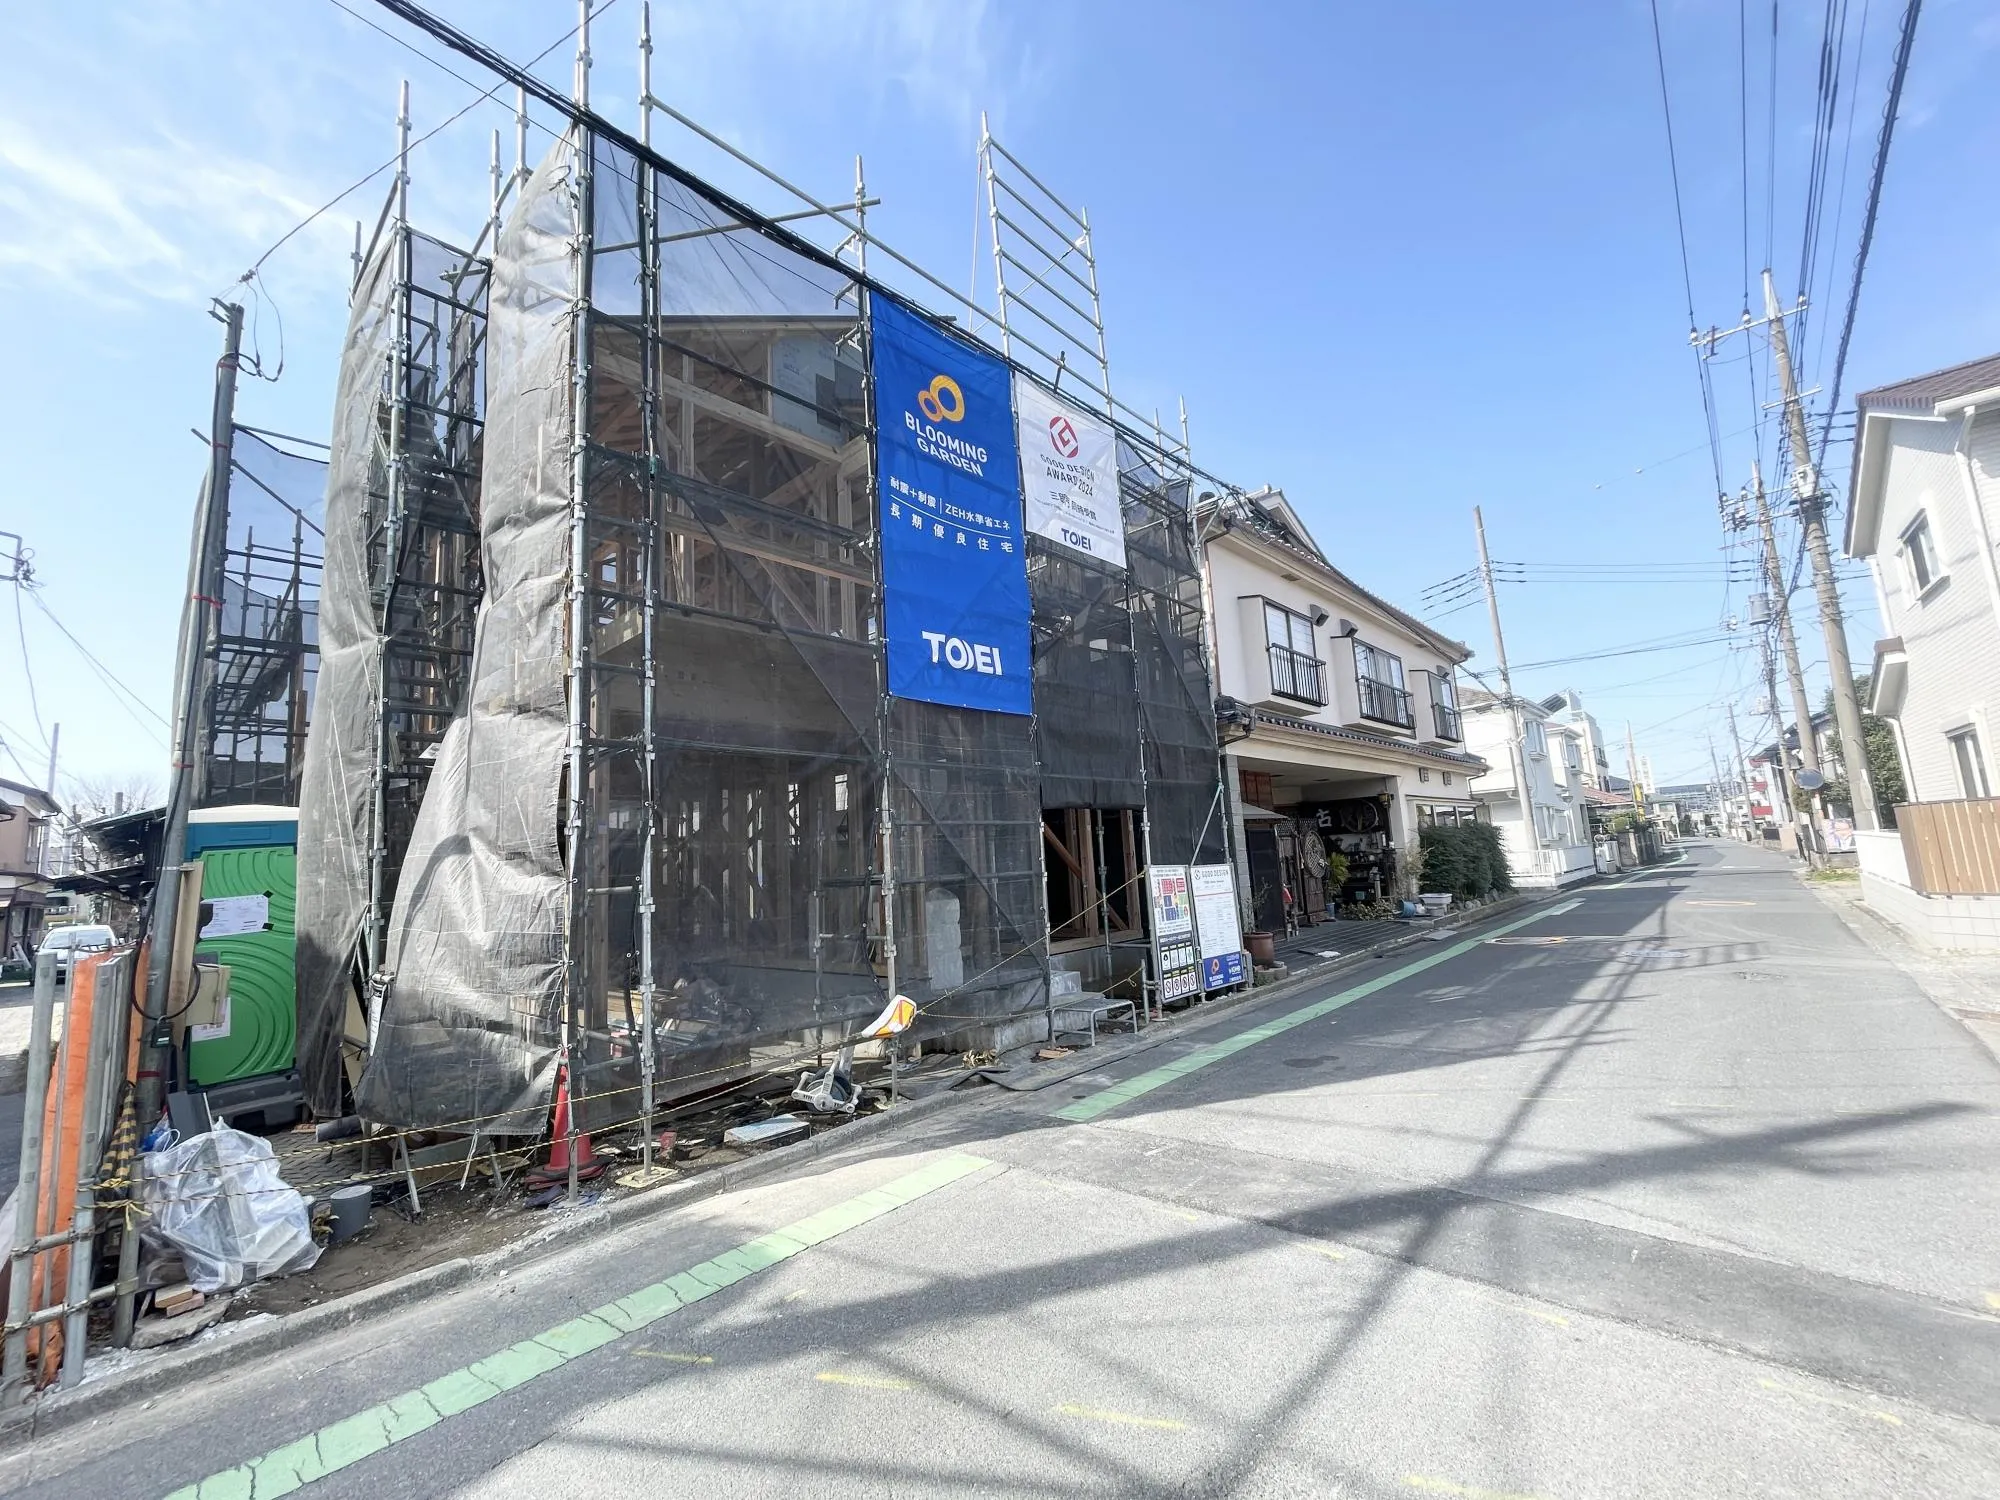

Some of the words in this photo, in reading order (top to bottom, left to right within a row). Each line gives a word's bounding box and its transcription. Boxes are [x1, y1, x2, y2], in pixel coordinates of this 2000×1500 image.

[904, 410, 988, 463] BLOOMING
[916, 437, 984, 478] GARDEN
[1040, 454, 1065, 469] GOOD
[1066, 464, 1094, 482] DESIGN
[1046, 467, 1078, 485] AWARD
[1078, 478, 1093, 496] 2024
